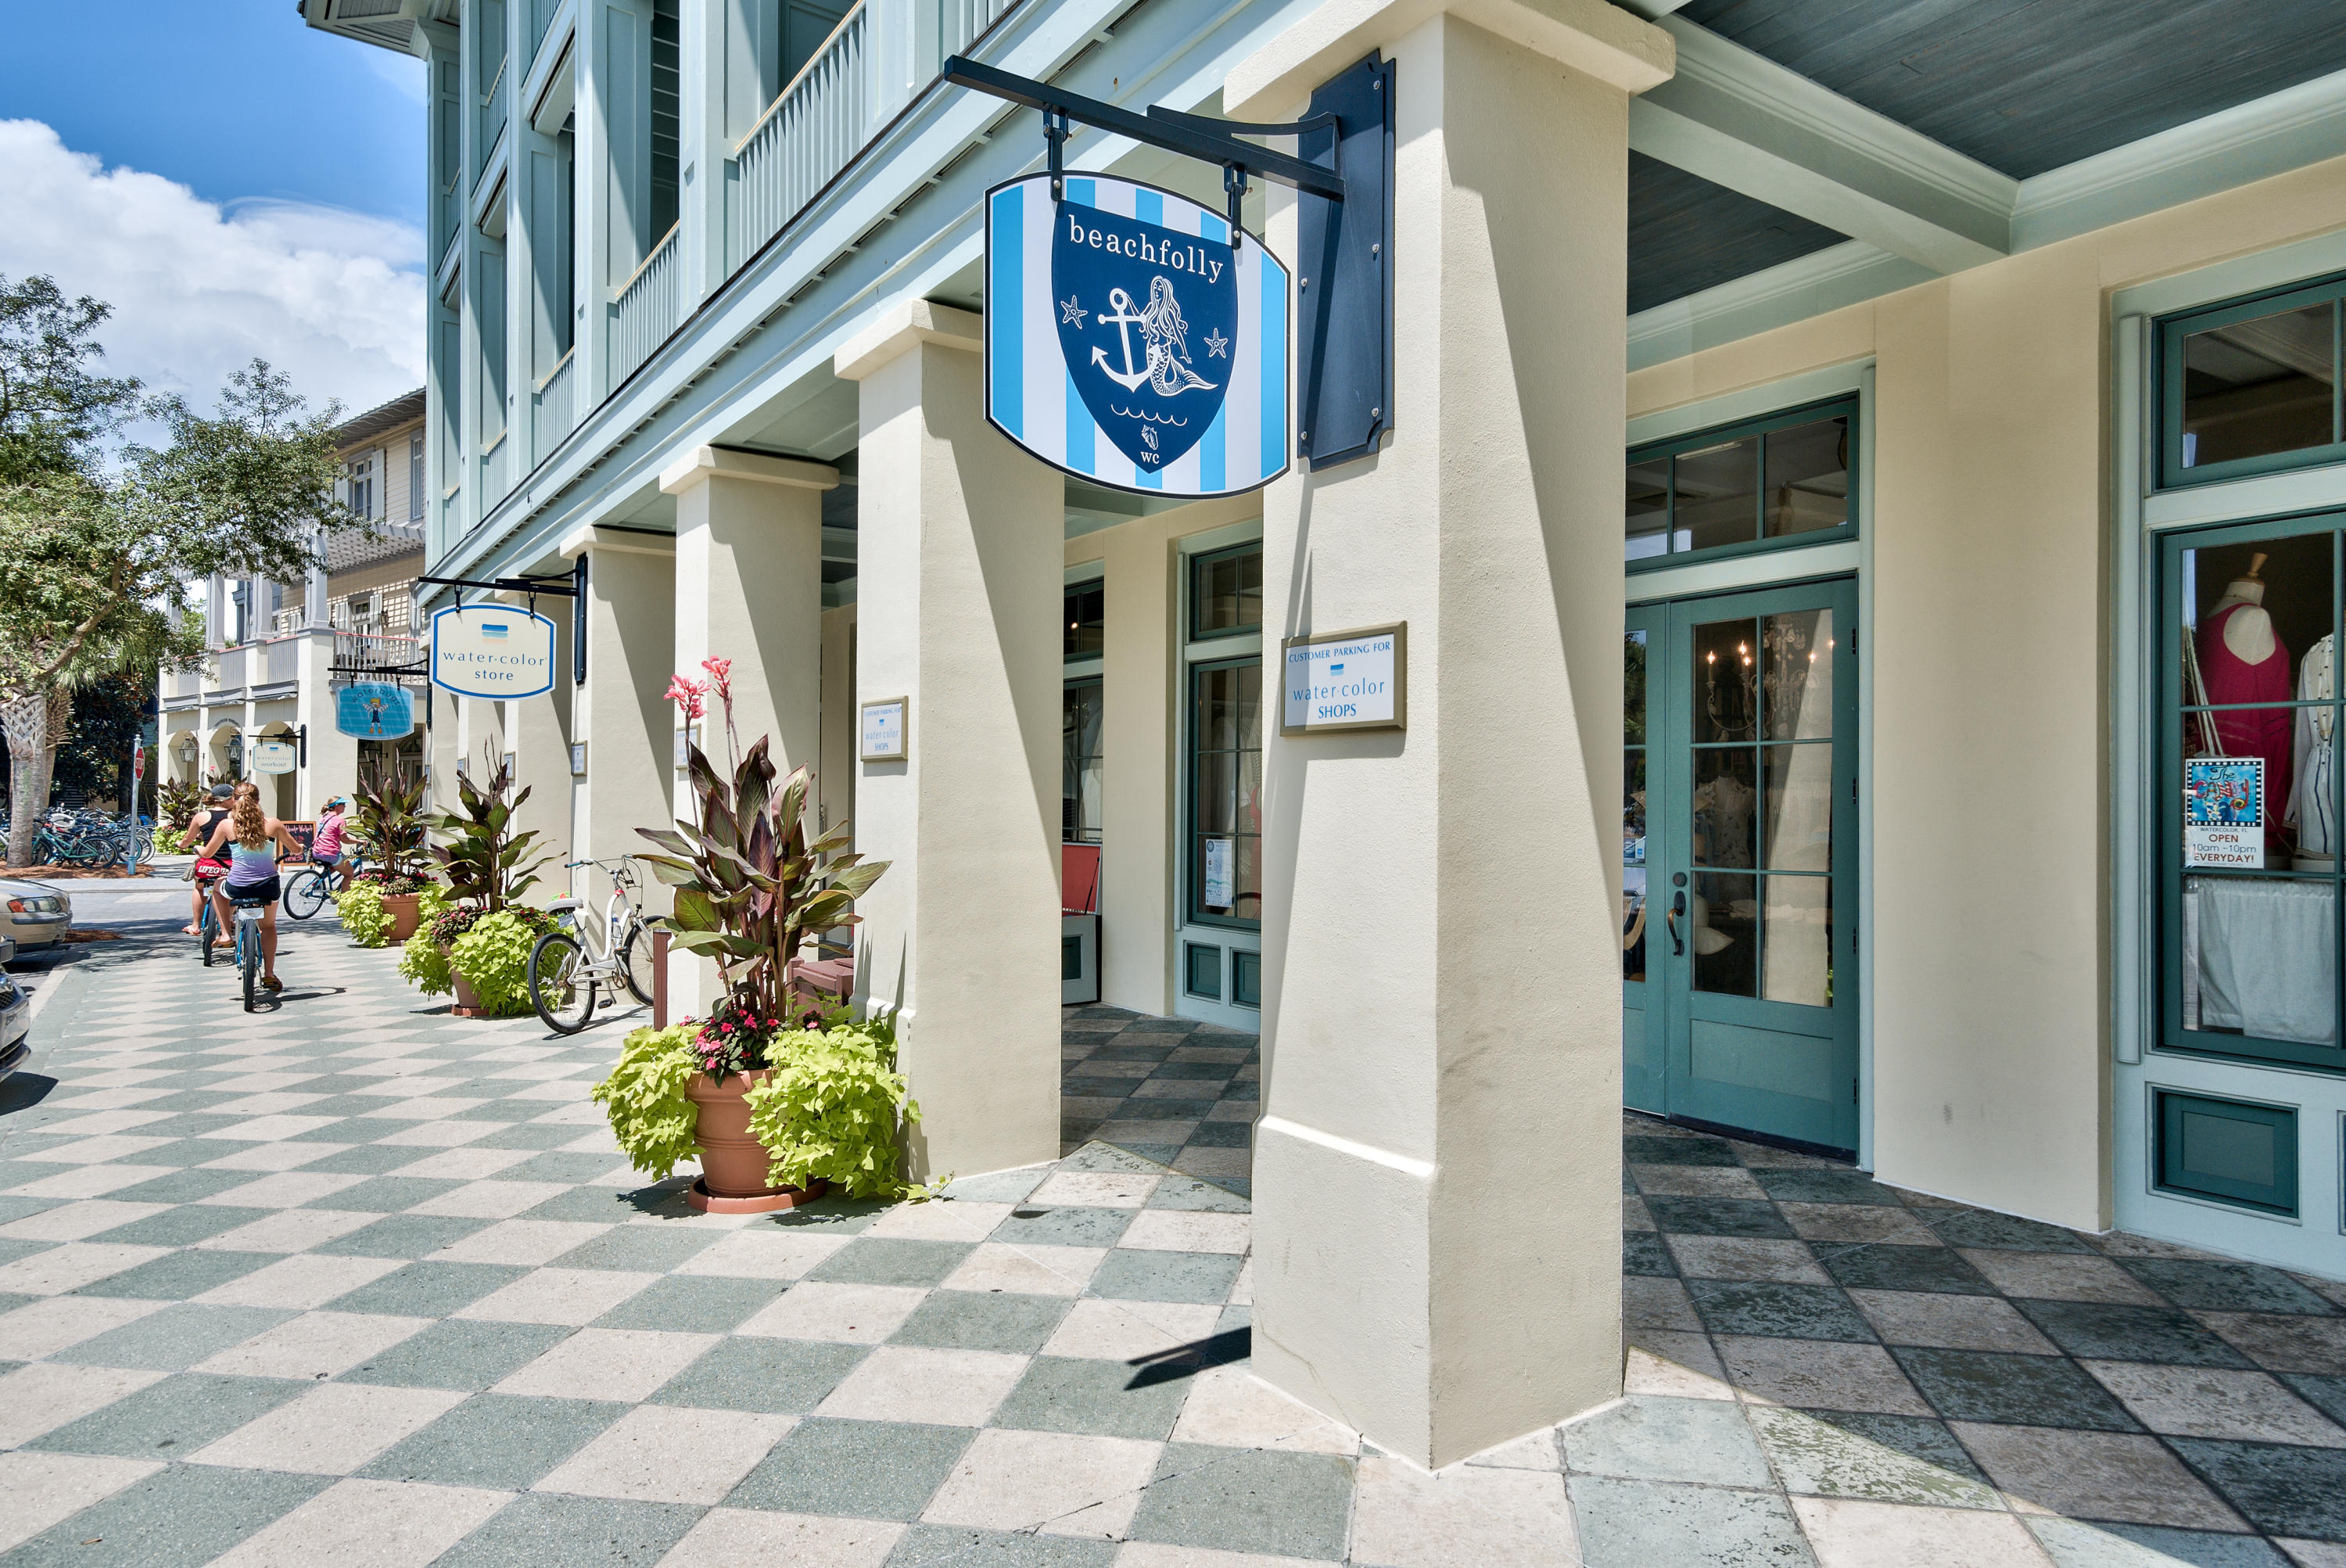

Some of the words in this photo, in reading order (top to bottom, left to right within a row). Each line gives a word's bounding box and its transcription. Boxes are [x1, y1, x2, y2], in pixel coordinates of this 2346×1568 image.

[1068, 214, 1223, 284] beachfolly
[1289, 649, 1330, 662] CUSTOMER
[1334, 644, 1369, 657] PARKING
[1373, 641, 1390, 652] FOR
[475, 670, 514, 681] store
[351, 687, 400, 705] waterbugs
[1318, 704, 1357, 719] SHOPS
[874, 742, 889, 751] SHOPS
[135, 757, 144, 770] STOP
[2209, 766, 2235, 780] The
[2208, 834, 2239, 843] OPEN
[2193, 843, 2219, 852] 10am
[2194, 853, 2254, 863] EVERYDAY!
